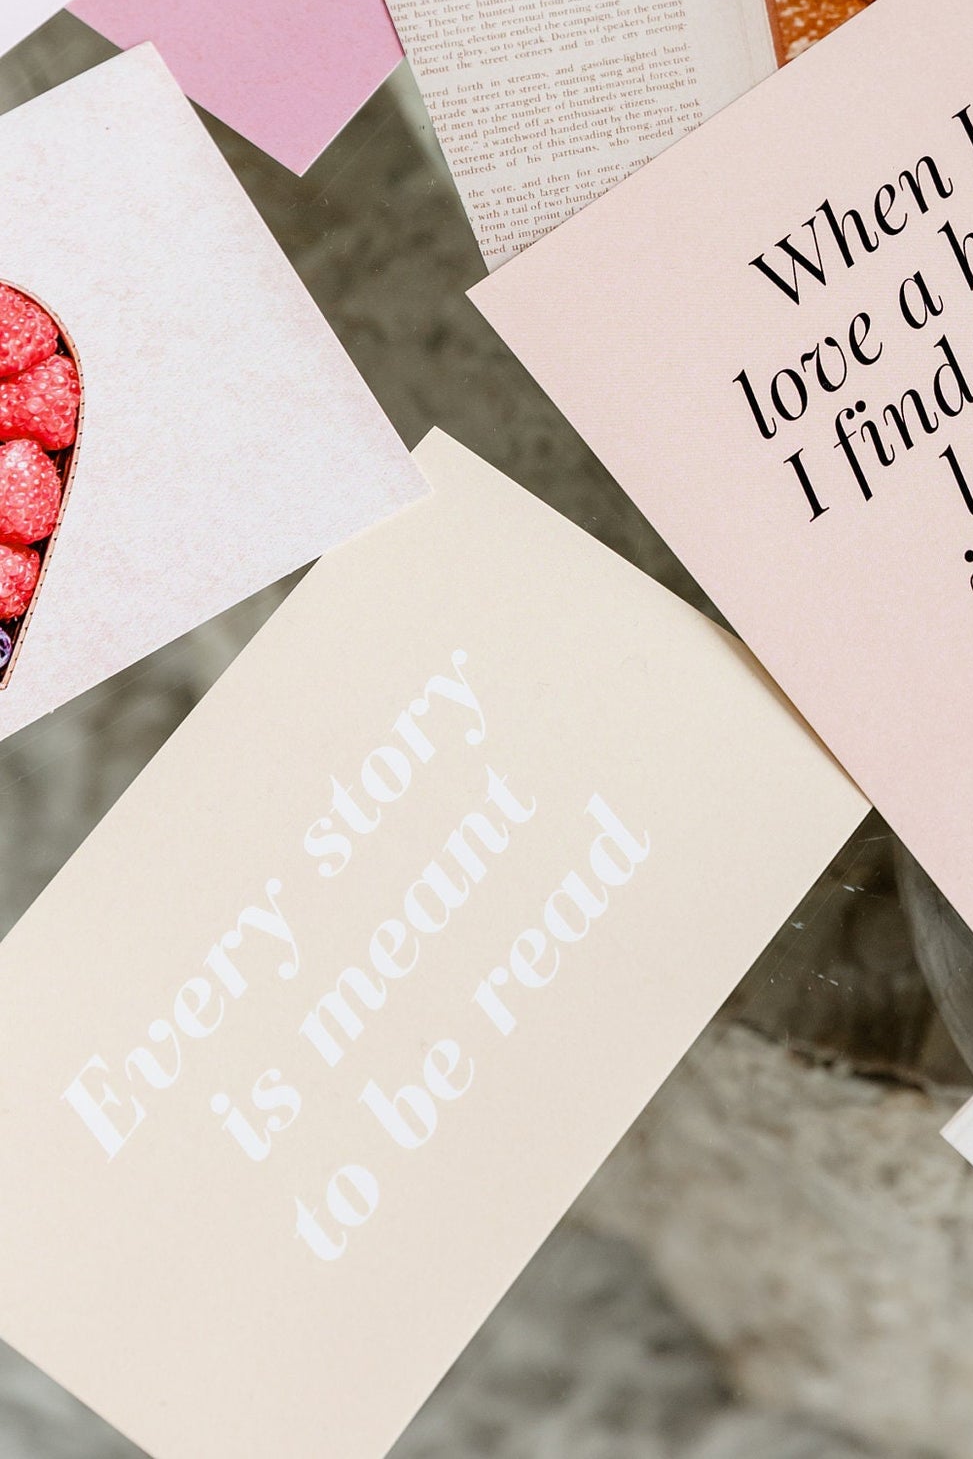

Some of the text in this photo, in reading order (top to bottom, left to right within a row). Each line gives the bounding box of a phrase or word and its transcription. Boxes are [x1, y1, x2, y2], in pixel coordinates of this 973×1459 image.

[419, 65, 449, 76] about
[456, 59, 472, 70] the
[479, 54, 509, 65] street
[514, 46, 553, 59] corners
[558, 39, 578, 51] and
[583, 38, 594, 46] in
[600, 34, 616, 44] the
[456, 81, 483, 93] forth
[506, 72, 549, 84] streams,
[555, 63, 574, 75] and
[430, 108, 466, 124] parade
[471, 106, 490, 114] was
[494, 92, 541, 110] arranged
[562, 88, 579, 97] the
[649, 69, 681, 80] forces,
[685, 65, 695, 73] in
[441, 97, 467, 108] from
[471, 91, 500, 102] street
[504, 88, 515, 96] to
[518, 82, 550, 94] street,
[625, 61, 645, 73] and
[450, 120, 473, 130] men
[490, 112, 507, 123] the
[510, 105, 550, 119] number
[554, 100, 565, 110] of
[568, 91, 617, 108] hundreds
[619, 88, 643, 98] were
[645, 78, 684, 92] brought
[686, 76, 697, 85] in
[452, 109, 703, 165] extreme ardor of this invading throng, and set to
[458, 129, 478, 140] and
[481, 120, 520, 139] palmed
[524, 117, 539, 128] off
[543, 117, 554, 125] as
[557, 103, 615, 122] enthusiastic
[487, 127, 547, 145] watchword
[549, 119, 588, 135] handed
[590, 117, 607, 127] out
[624, 110, 640, 120] the
[642, 105, 677, 117] mayor,
[679, 98, 700, 110] took
[505, 126, 674, 167] of his partisans, who needed
[467, 163, 624, 198] the vote, and then for once,
[471, 201, 490, 209] was
[505, 190, 535, 203] much
[538, 185, 570, 197] larger
[574, 180, 596, 189] vote
[599, 175, 620, 185] cast
[477, 209, 500, 220] with
[511, 202, 528, 214] tail
[530, 199, 541, 210] of
[543, 198, 562, 208] two
[479, 206, 577, 232] from one point of
[749, 155, 954, 306] When
[482, 243, 507, 256] used
[494, 230, 514, 242] had
[732, 312, 883, 440] love
[899, 270, 944, 330] a
[783, 448, 830, 523] I
[60, 649, 487, 1163] Every story
[210, 764, 537, 1162] is meant
[293, 793, 651, 1261] to be read
